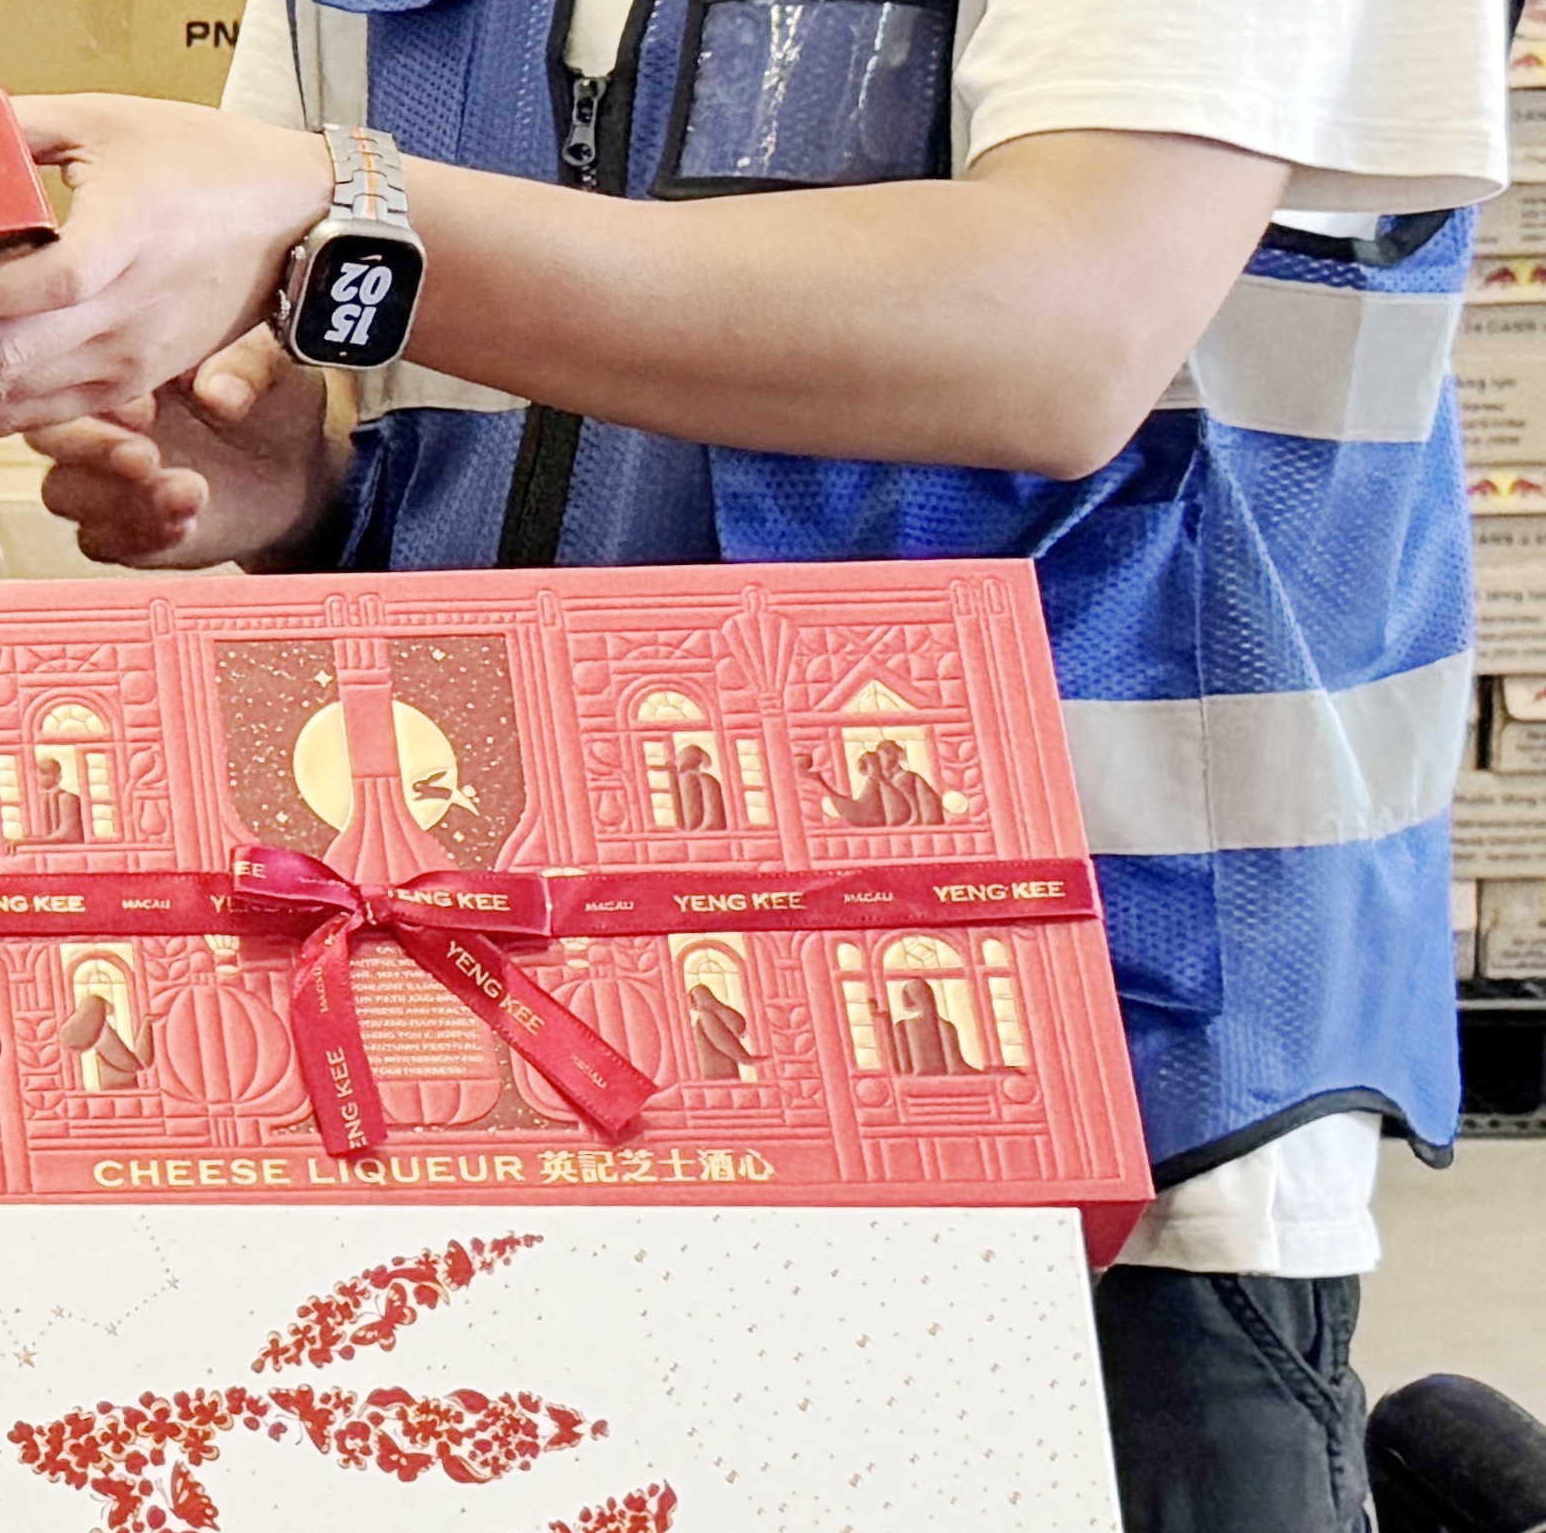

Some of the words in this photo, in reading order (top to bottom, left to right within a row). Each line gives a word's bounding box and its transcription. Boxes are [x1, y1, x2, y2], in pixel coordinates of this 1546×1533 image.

[330, 262, 393, 305] 02
[324, 303, 377, 345] 15
[234, 861, 266, 879] EE
[33, 895, 86, 913] KEE
[458, 892, 512, 912] KEE
[673, 893, 748, 914] YENG
[752, 891, 806, 911] KEE
[933, 883, 1008, 903] YENG
[1011, 881, 1065, 900] KEE
[446, 940, 502, 1000] YENG
[498, 995, 547, 1036] KEE
[326, 1047, 354, 1096] KEE
[93, 1159, 289, 1187] CHEESE
[308, 1155, 526, 1187] LIQUEUR
